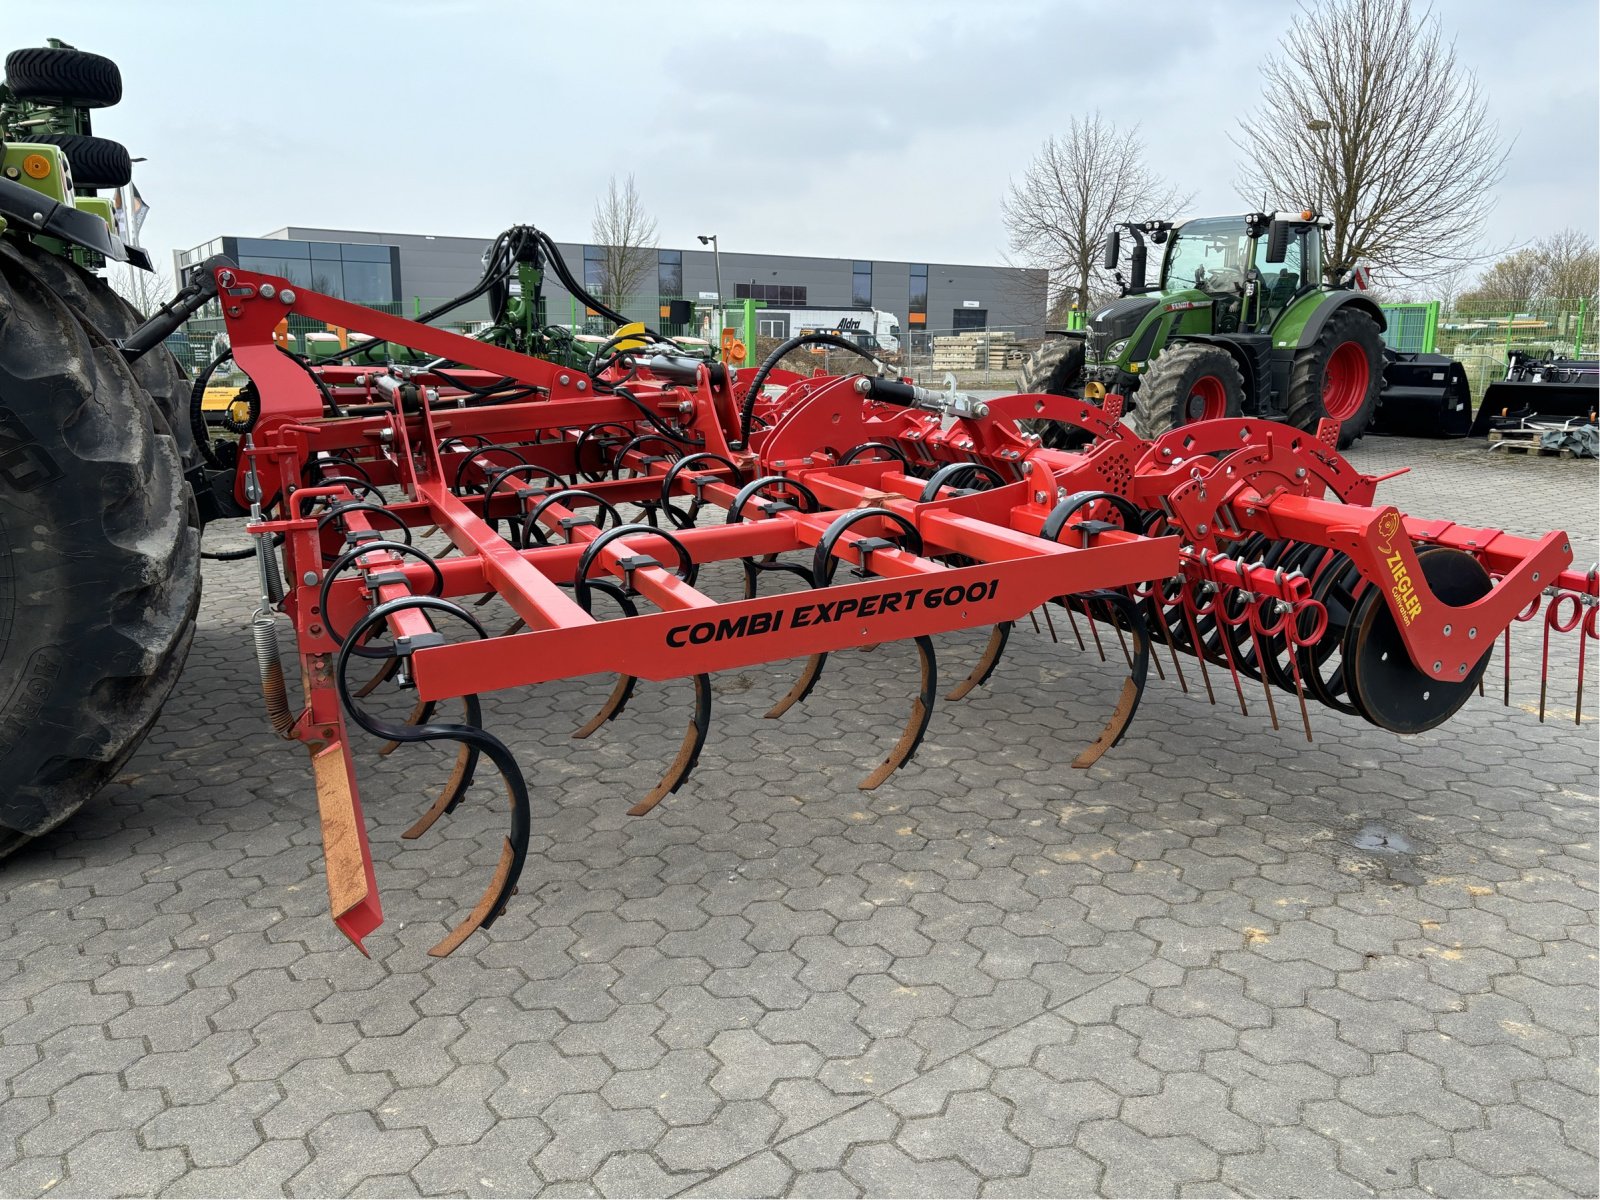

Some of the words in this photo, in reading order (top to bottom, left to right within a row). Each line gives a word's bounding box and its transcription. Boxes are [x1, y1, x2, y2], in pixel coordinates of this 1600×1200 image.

[836, 317, 861, 329] Aldra
[1387, 551, 1421, 621] ZIEGLER
[1392, 586, 1411, 626] Cultivation
[665, 609, 784, 649] COMBI
